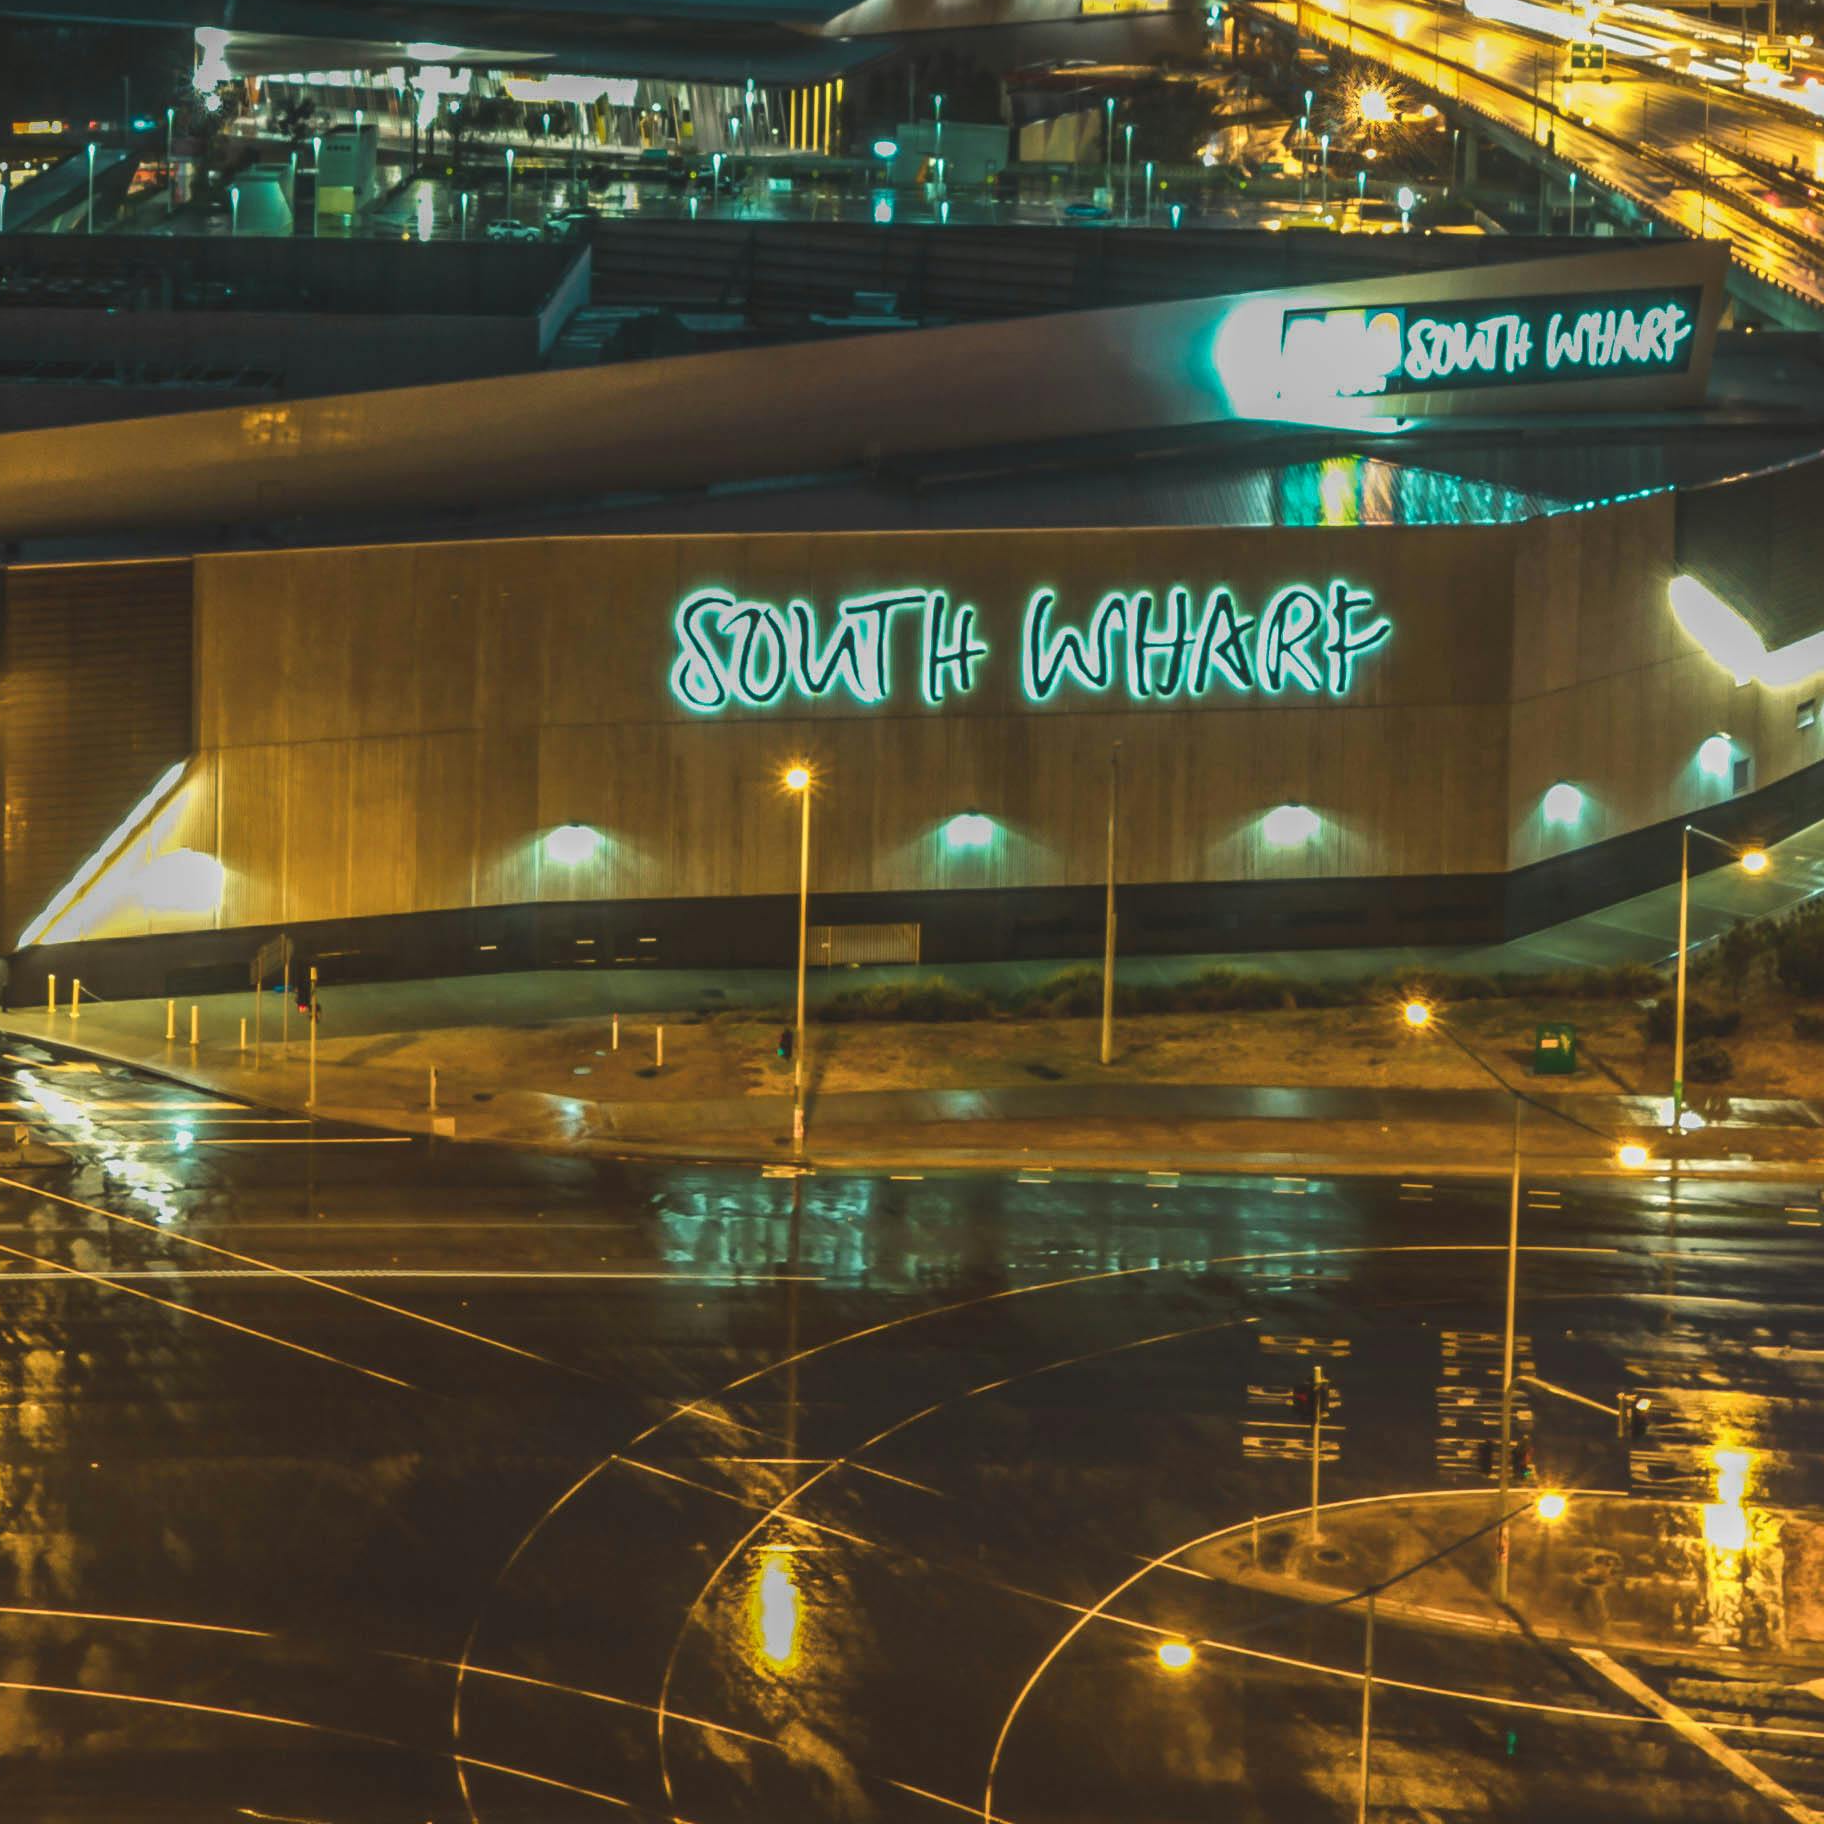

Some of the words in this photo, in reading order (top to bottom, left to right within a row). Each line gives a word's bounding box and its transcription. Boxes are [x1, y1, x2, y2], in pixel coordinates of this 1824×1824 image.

[1405, 314, 1532, 379] SOUTH
[1544, 303, 1692, 369] WHARF
[674, 588, 988, 712] SOUTH
[1021, 579, 1392, 700] WHARF
